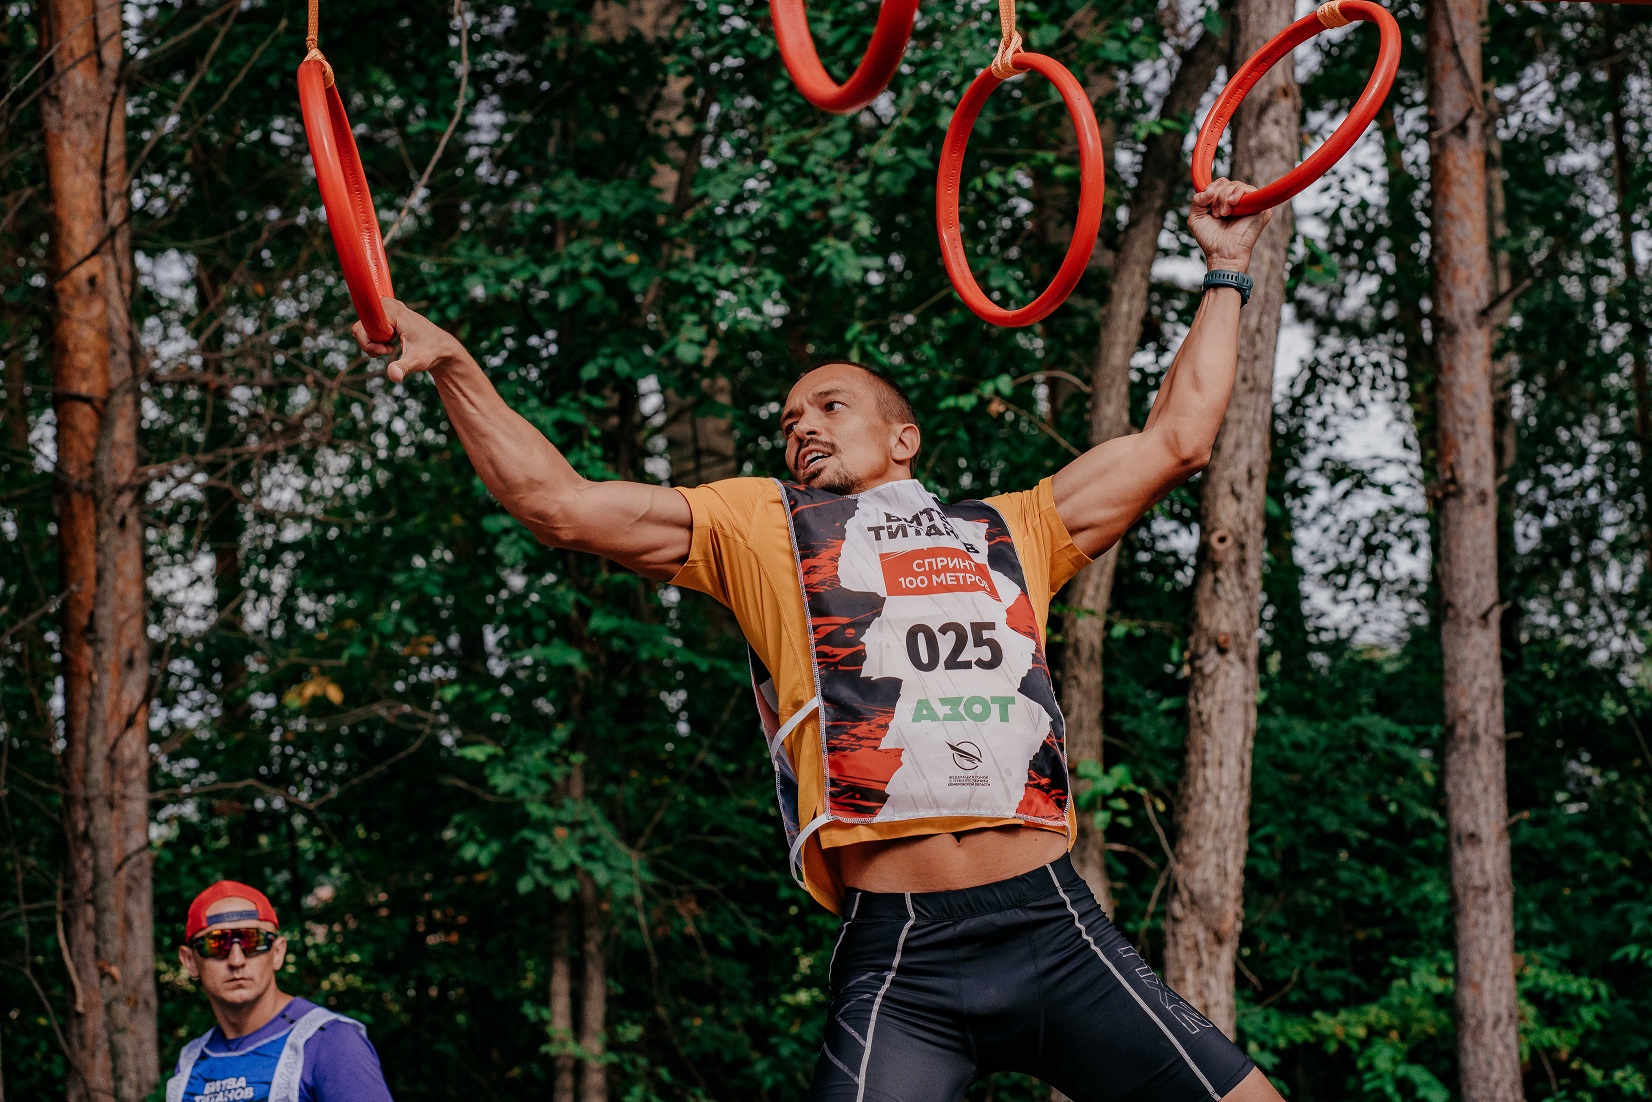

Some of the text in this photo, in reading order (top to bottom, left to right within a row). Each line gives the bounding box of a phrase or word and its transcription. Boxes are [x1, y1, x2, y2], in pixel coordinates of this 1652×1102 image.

[912, 556, 976, 572] СПРИНТ
[898, 575, 928, 589] 100
[905, 621, 1004, 672] 025
[911, 695, 1016, 723] АЗОТ
[203, 1076, 247, 1094] БИТВА
